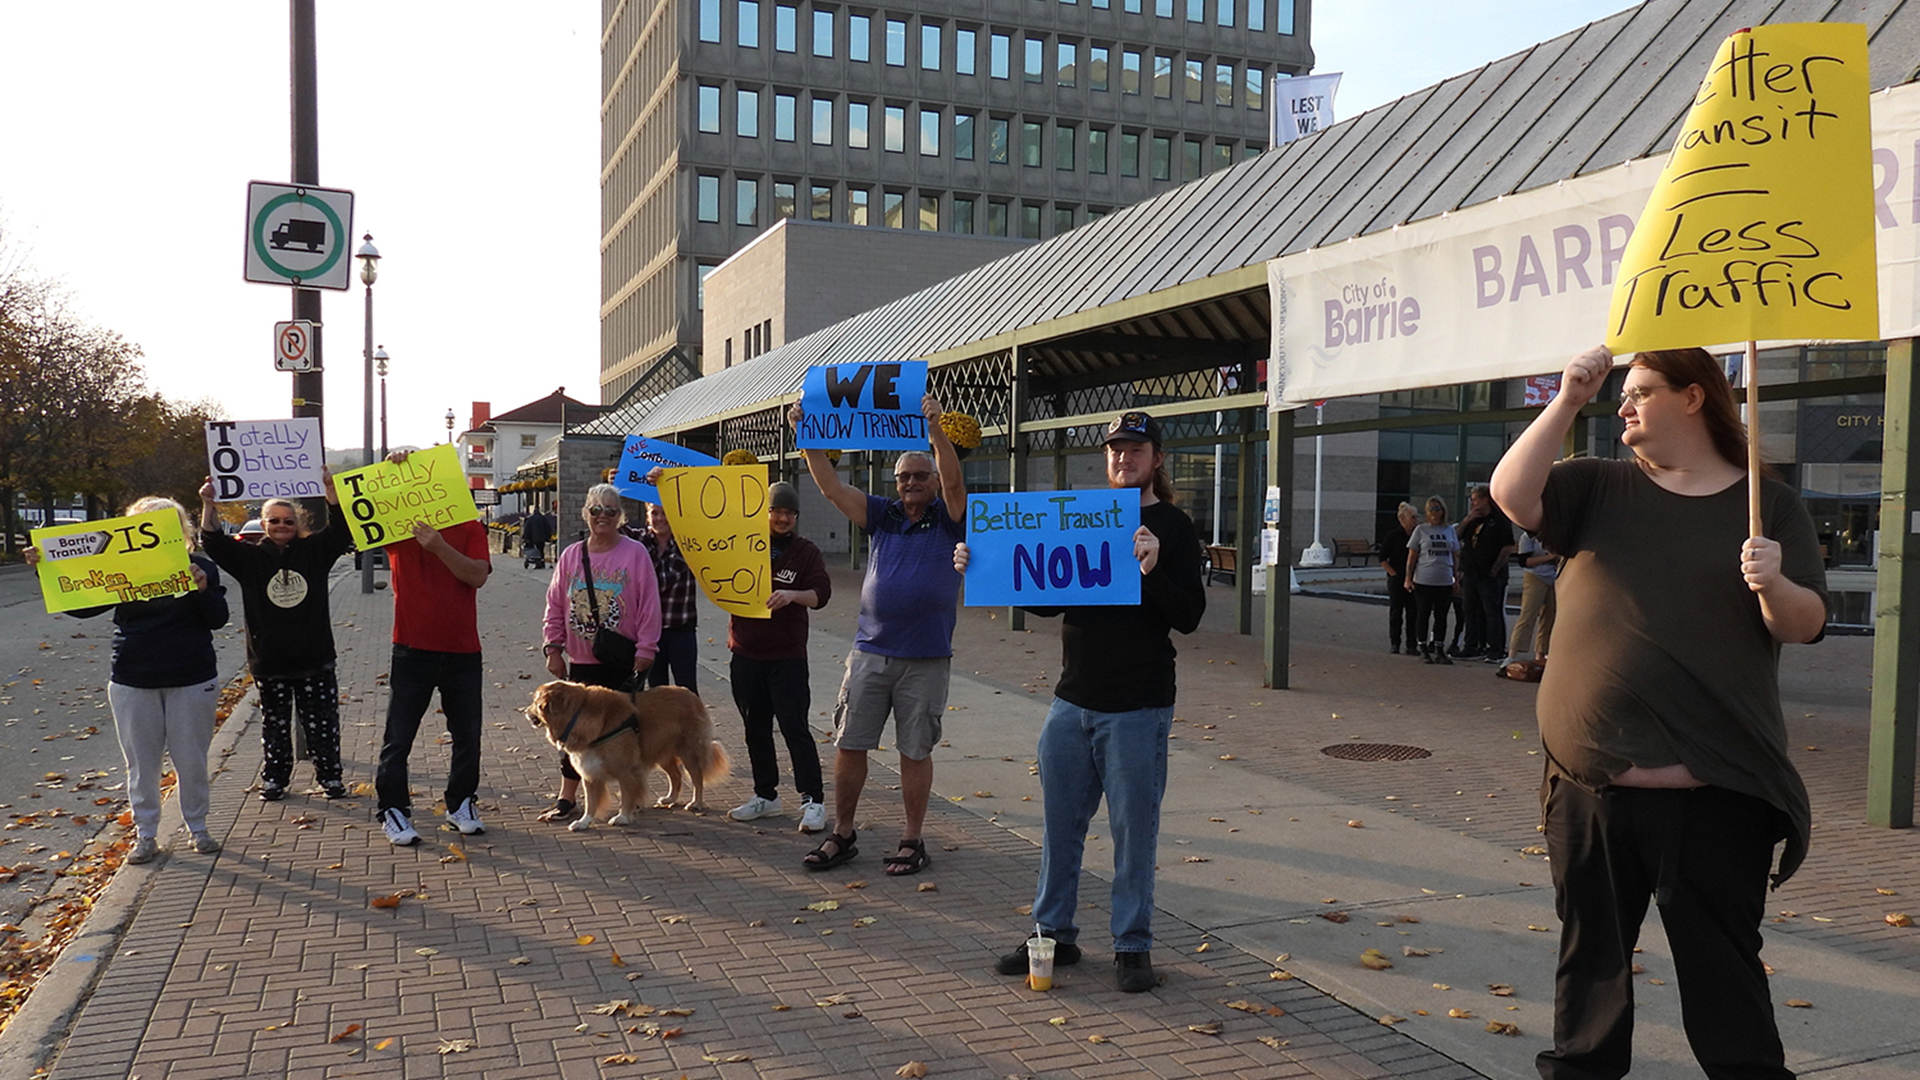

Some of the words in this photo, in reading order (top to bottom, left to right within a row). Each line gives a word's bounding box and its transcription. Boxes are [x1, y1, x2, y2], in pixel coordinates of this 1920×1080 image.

[1695, 39, 1844, 106] etter
[1291, 95, 1324, 115] LEST
[1296, 117, 1318, 134] WE
[1666, 99, 1838, 169] ransit
[1659, 213, 1820, 261] Less
[1343, 284, 1369, 307] City
[1373, 277, 1386, 299] of
[1617, 260, 1852, 336] Traffic
[1324, 285, 1421, 348] Barrie
[825, 364, 902, 410] WE
[209, 422, 309, 450] Totally
[801, 413, 855, 439] KNOW
[857, 412, 927, 439] TRANSIT
[1836, 415, 1872, 427] CITY
[213, 448, 312, 473] Obtuse
[626, 439, 649, 454] WE
[217, 475, 321, 499] Decision
[343, 459, 436, 498] Totally
[351, 483, 448, 521] Obvious
[970, 499, 1048, 533] Better
[1048, 496, 1124, 530] Transit
[49, 545, 93, 559] Transit
[58, 534, 97, 548] Barrie
[681, 534, 702, 551] HAS
[707, 535, 737, 551] GOT
[746, 533, 767, 552] TO
[1013, 541, 1112, 591] NOW
[105, 571, 191, 603] Transit
[700, 565, 763, 604] GO!
